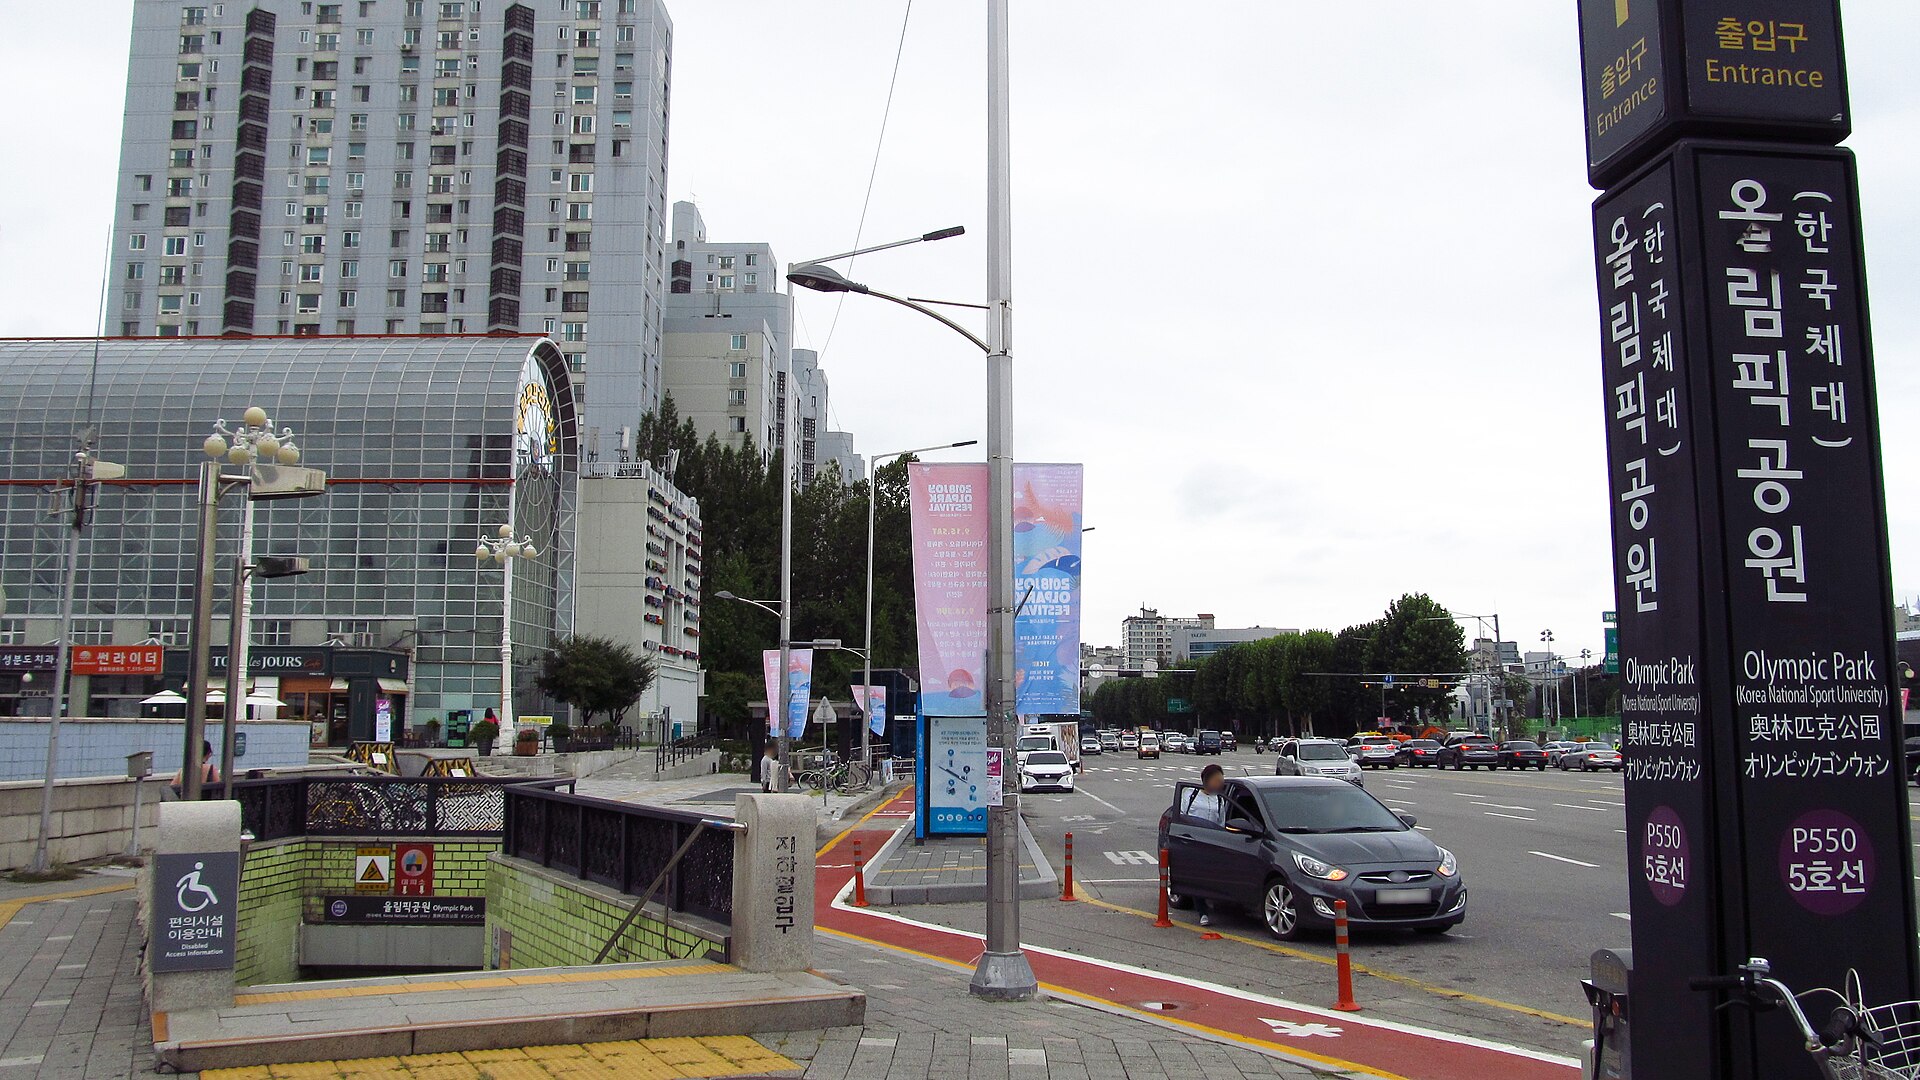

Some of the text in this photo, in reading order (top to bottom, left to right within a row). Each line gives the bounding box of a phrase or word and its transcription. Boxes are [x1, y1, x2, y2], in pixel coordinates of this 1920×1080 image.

[1715, 17, 1808, 53] 출입구
[1600, 37, 1647, 100] 출입구
[1705, 59, 1824, 88] Entrance
[1596, 76, 1657, 137] Entrance
[1642, 201, 1682, 456] (한국체대)
[1791, 191, 1853, 448] (한국체대)
[1718, 179, 1808, 603] 올림픽공원
[1605, 216, 1658, 613] 올림픽공원
[34, 654, 55, 665] 치과
[97, 651, 157, 665] 썬라이더
[248, 656, 261, 667] les
[261, 656, 302, 669] JOURS
[1743, 649, 1877, 685] Olympic Park
[1626, 655, 1695, 692] Olympic Park
[1736, 684, 1767, 706] (Korea
[1768, 684, 1808, 704] National
[1809, 684, 1836, 708] Sport
[1627, 720, 1695, 748] 奥林匹克公园
[1749, 713, 1882, 741] 奥林匹克公园
[1744, 750, 1890, 779] オリンピックゴンウォン
[1647, 822, 1681, 850] P550
[1792, 827, 1857, 854] P550
[1645, 854, 1685, 890] 5호선
[1788, 859, 1866, 895] 5호선
[383, 900, 431, 914] 올림픽공원
[432, 904, 459, 912] Olympic
[168, 915, 223, 928] 편의시설
[168, 927, 223, 940] 이용안내
[181, 942, 208, 950] Disabled
[187, 949, 223, 957] Information
